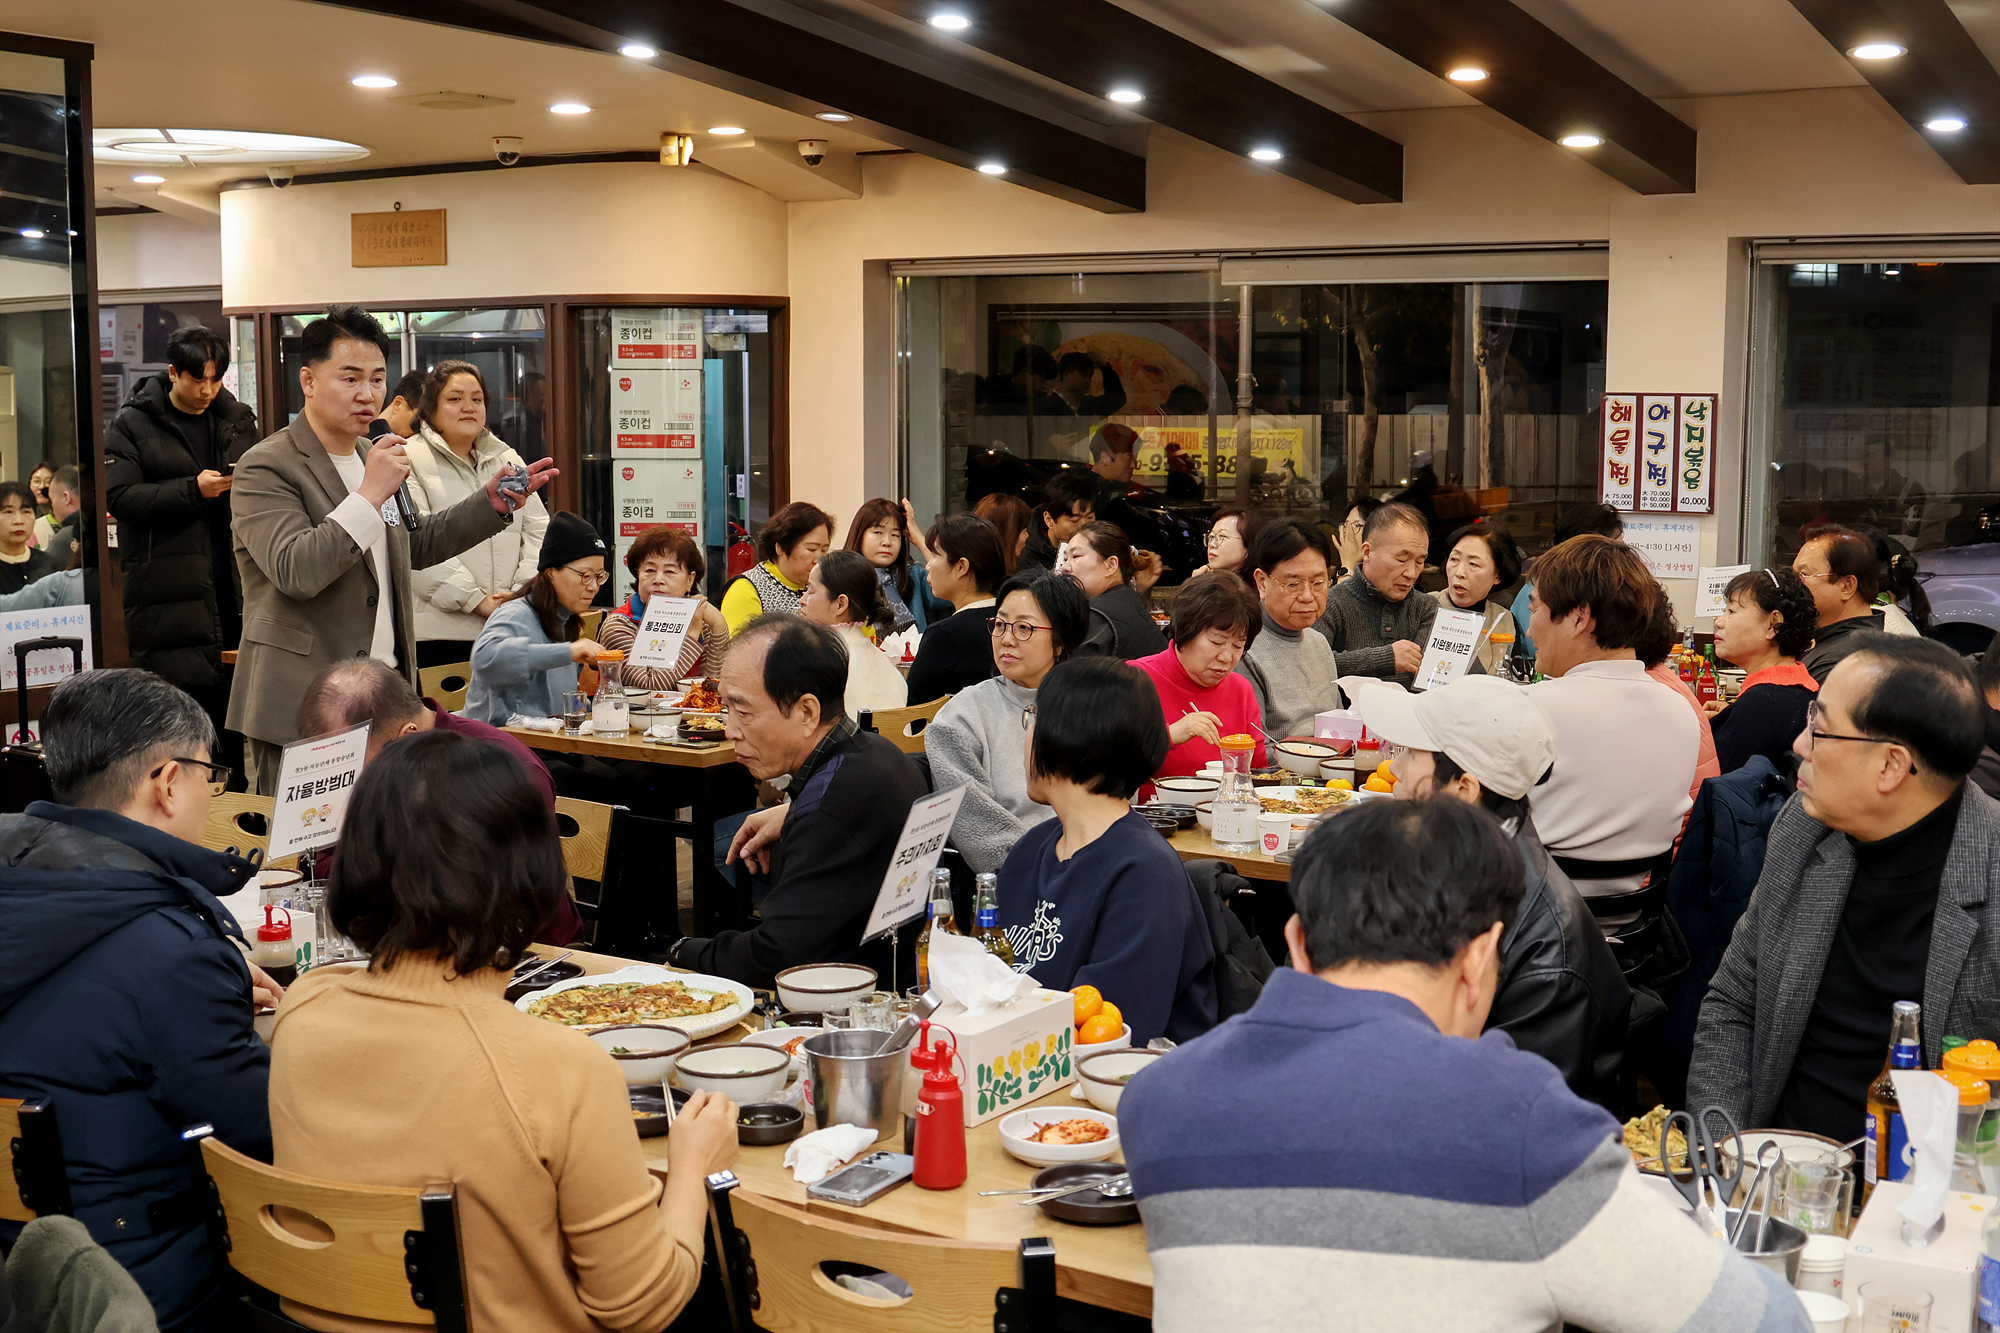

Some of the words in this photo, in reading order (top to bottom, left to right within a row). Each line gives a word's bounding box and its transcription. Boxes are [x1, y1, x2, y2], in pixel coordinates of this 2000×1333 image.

[620, 327, 652, 340] 종이컵
[619, 417, 651, 430] 종이컵
[1608, 399, 1632, 486] 해물찜
[1646, 403, 1671, 487] 아구찜
[1684, 400, 1708, 490] 낙지볶음
[1680, 497, 1707, 505] 40,000
[622, 506, 653, 518] 종이컵
[5, 619, 39, 632] 재료준비
[645, 621, 684, 634] 통장협의회
[1431, 637, 1471, 655] 자원봉사캠프
[285, 769, 355, 803] 자율방범대
[895, 831, 945, 869] 주민자치회
